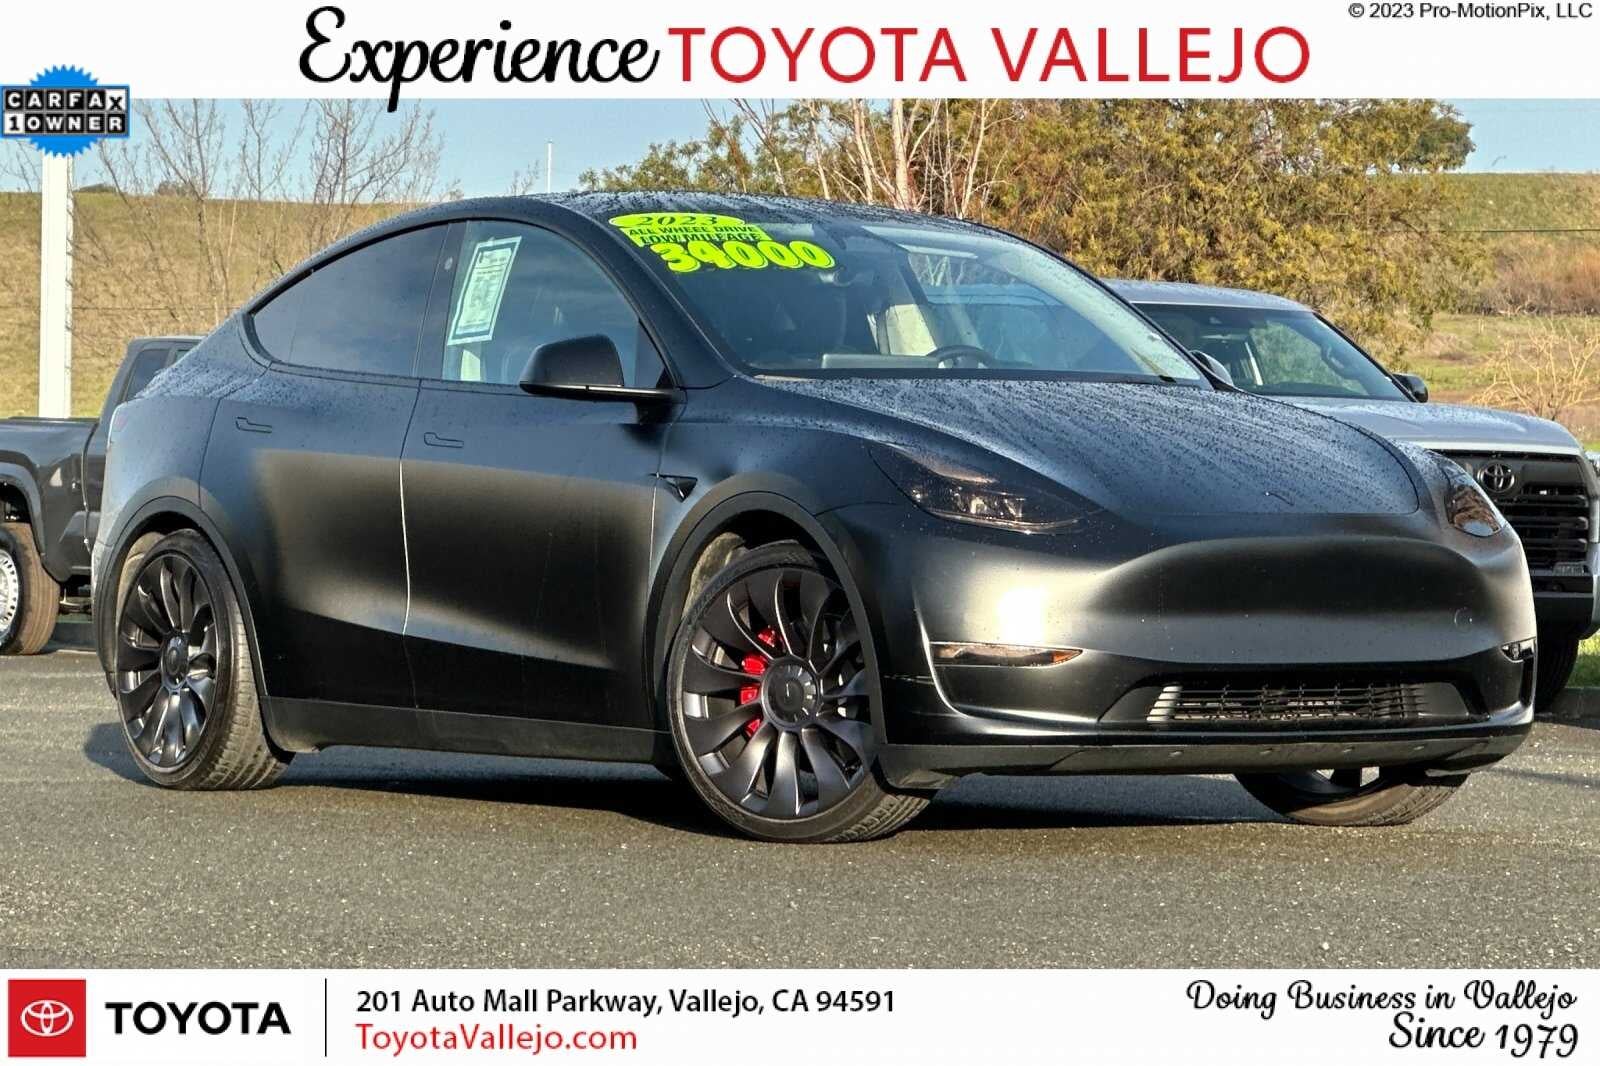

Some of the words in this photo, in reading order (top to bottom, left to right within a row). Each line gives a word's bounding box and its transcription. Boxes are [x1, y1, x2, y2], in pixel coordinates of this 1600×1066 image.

[638, 215, 718, 226] 2023
[629, 227, 657, 236] ALL
[659, 225, 710, 234] WHEEL
[712, 225, 756, 234] DRIVE
[640, 233, 678, 244] LOW
[682, 232, 761, 243] MILEAGE
[650, 240, 836, 273] 34000
